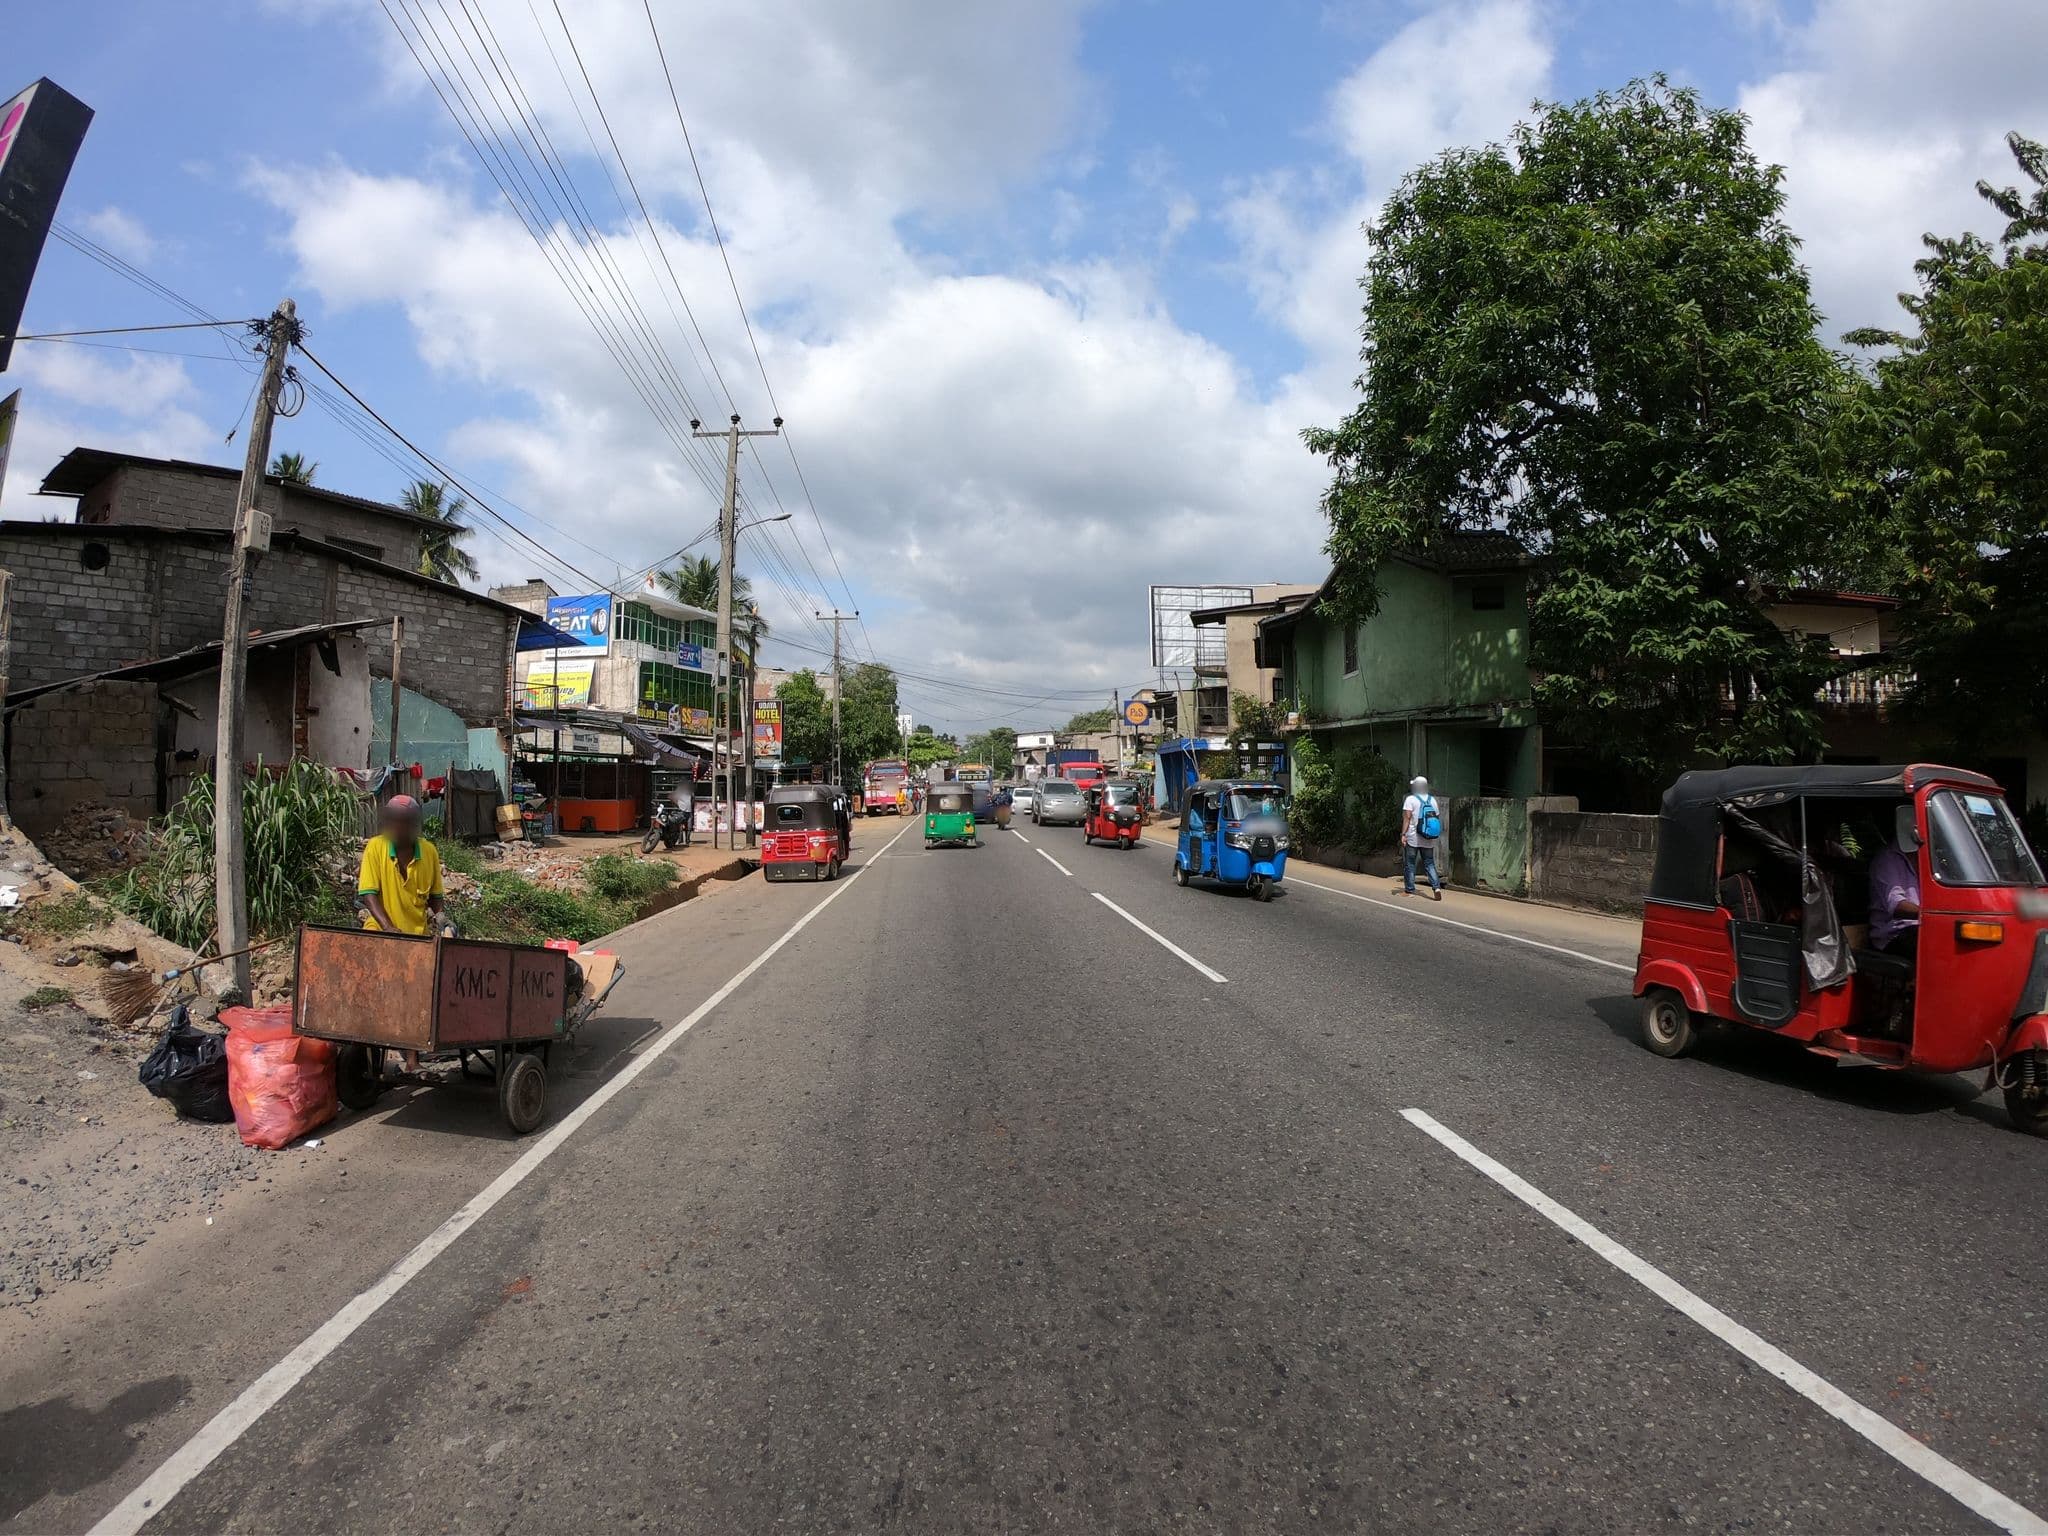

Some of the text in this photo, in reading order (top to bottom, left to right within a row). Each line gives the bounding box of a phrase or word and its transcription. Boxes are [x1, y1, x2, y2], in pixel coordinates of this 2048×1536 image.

[548, 615, 590, 632] CEAT
[679, 650, 695, 661] CEAT
[755, 709, 780, 719] HOTEL
[455, 965, 498, 999] KMC
[521, 970, 555, 998] KMC
